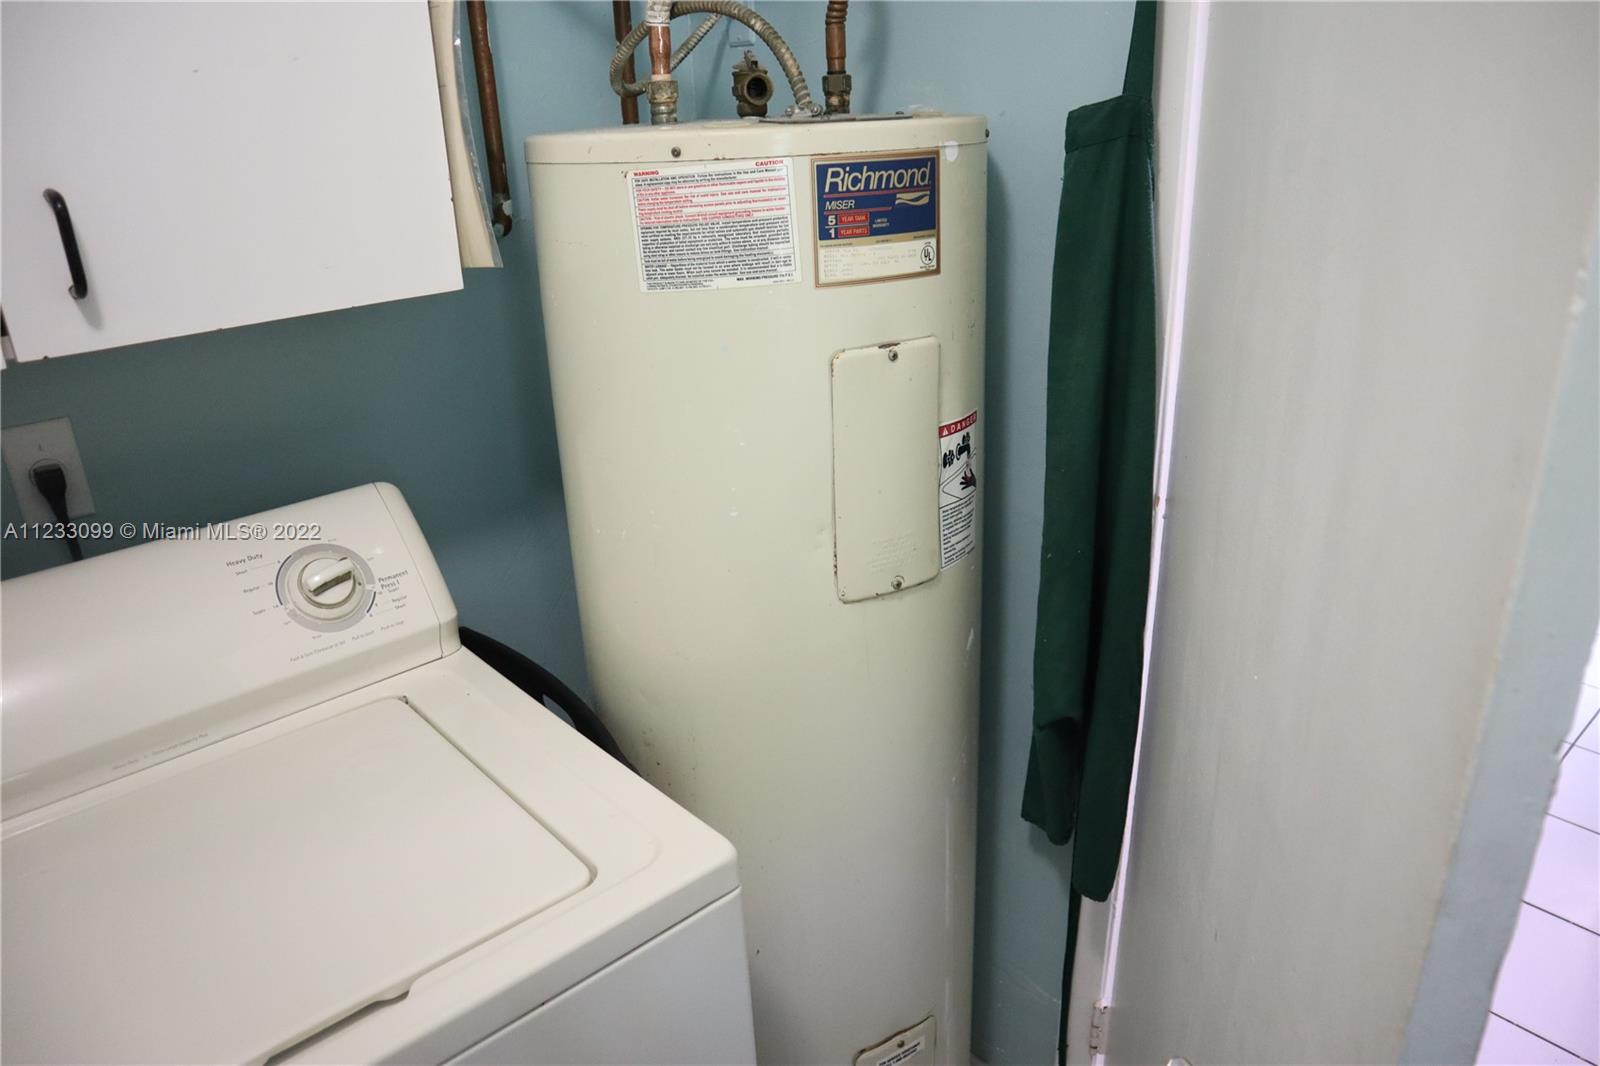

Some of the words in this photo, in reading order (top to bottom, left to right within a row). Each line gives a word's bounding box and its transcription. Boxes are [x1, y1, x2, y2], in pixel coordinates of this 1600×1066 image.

[824, 161, 931, 192] Richmond
[825, 199, 856, 211] MISER
[828, 215, 836, 226] 5
[829, 228, 836, 239] 1
[853, 227, 868, 235] PARTS
[950, 413, 977, 433] DANGER
